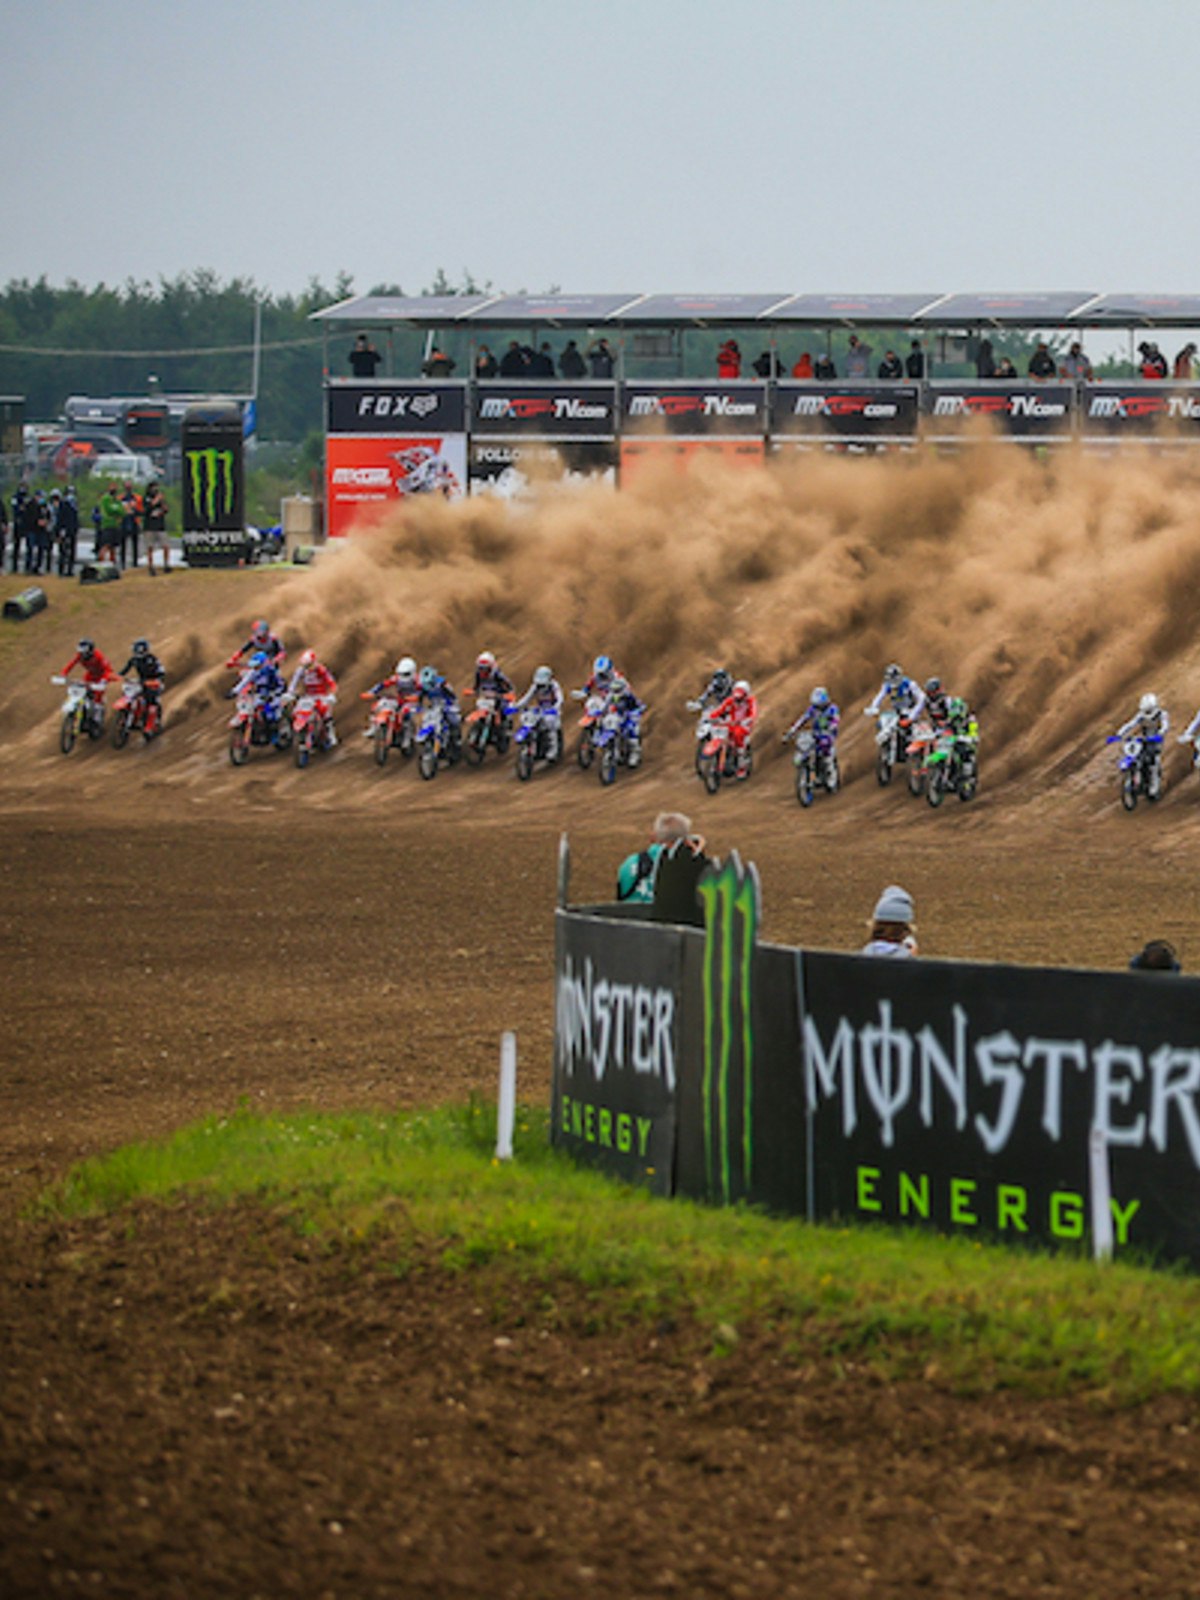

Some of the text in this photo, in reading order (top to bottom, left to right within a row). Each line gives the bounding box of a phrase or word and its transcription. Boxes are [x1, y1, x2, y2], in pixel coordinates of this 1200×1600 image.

[358, 396, 407, 416] FOX
[562, 1094, 652, 1157] ENERGY
[857, 1165, 1141, 1245] ENERGY
